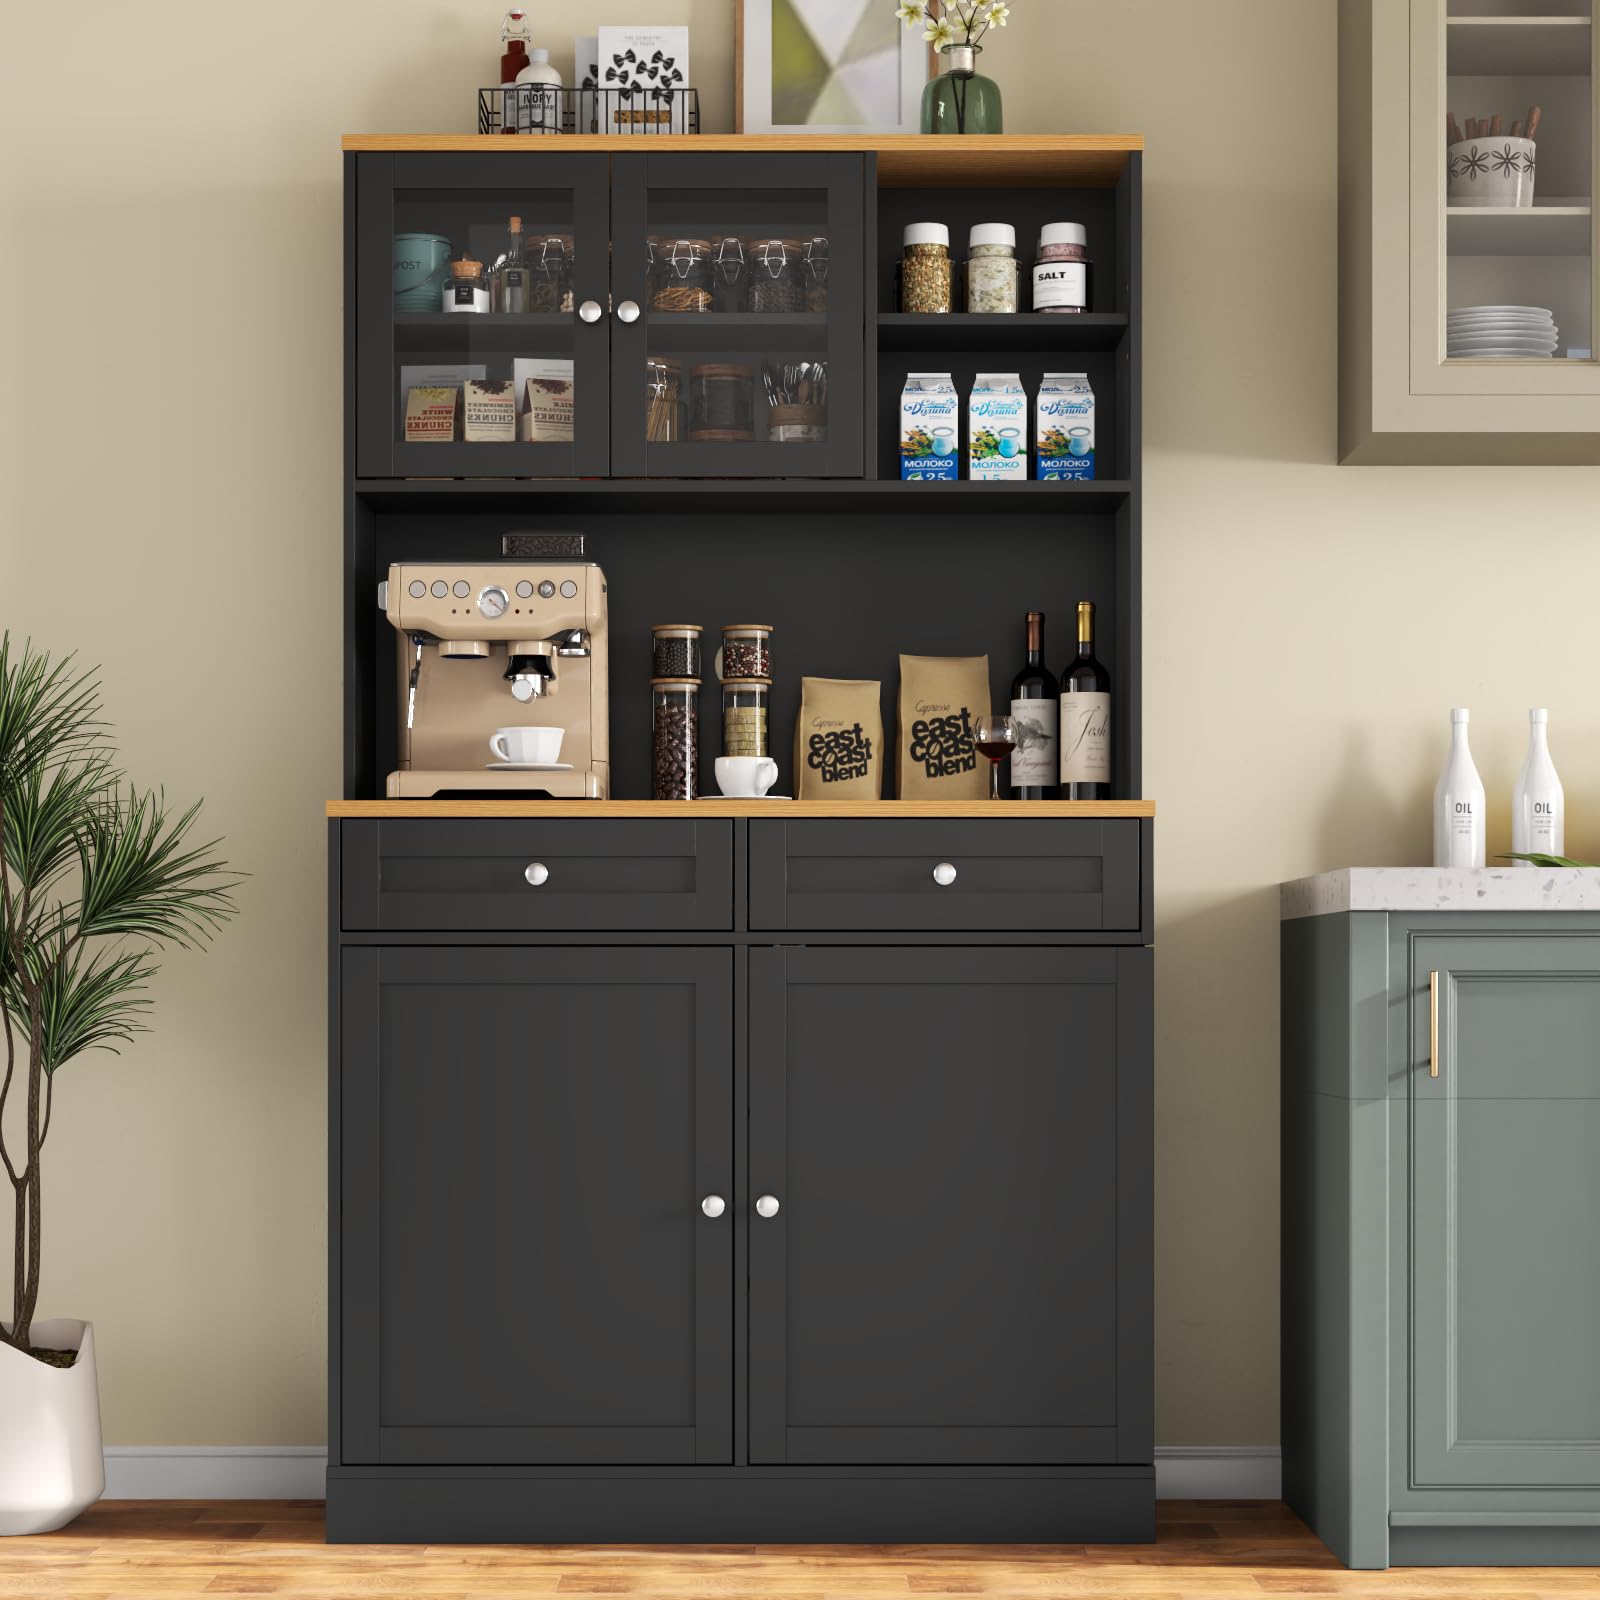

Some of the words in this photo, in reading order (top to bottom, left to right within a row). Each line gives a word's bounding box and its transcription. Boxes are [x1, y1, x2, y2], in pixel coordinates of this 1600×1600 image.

[523, 94, 552, 105] IVORY
[1038, 271, 1067, 281] SALT
[904, 459, 954, 468] МОЛОКО
[971, 461, 1020, 469] МОЛОКО
[1041, 459, 1090, 468] МОЛОКО
[911, 707, 972, 742] east
[809, 723, 865, 752] east
[910, 730, 979, 762] coas
[808, 738, 872, 769] coast
[925, 749, 977, 778] blend
[821, 757, 868, 783] blend
[1455, 802, 1473, 814] OIL
[1534, 802, 1553, 814] OIL
